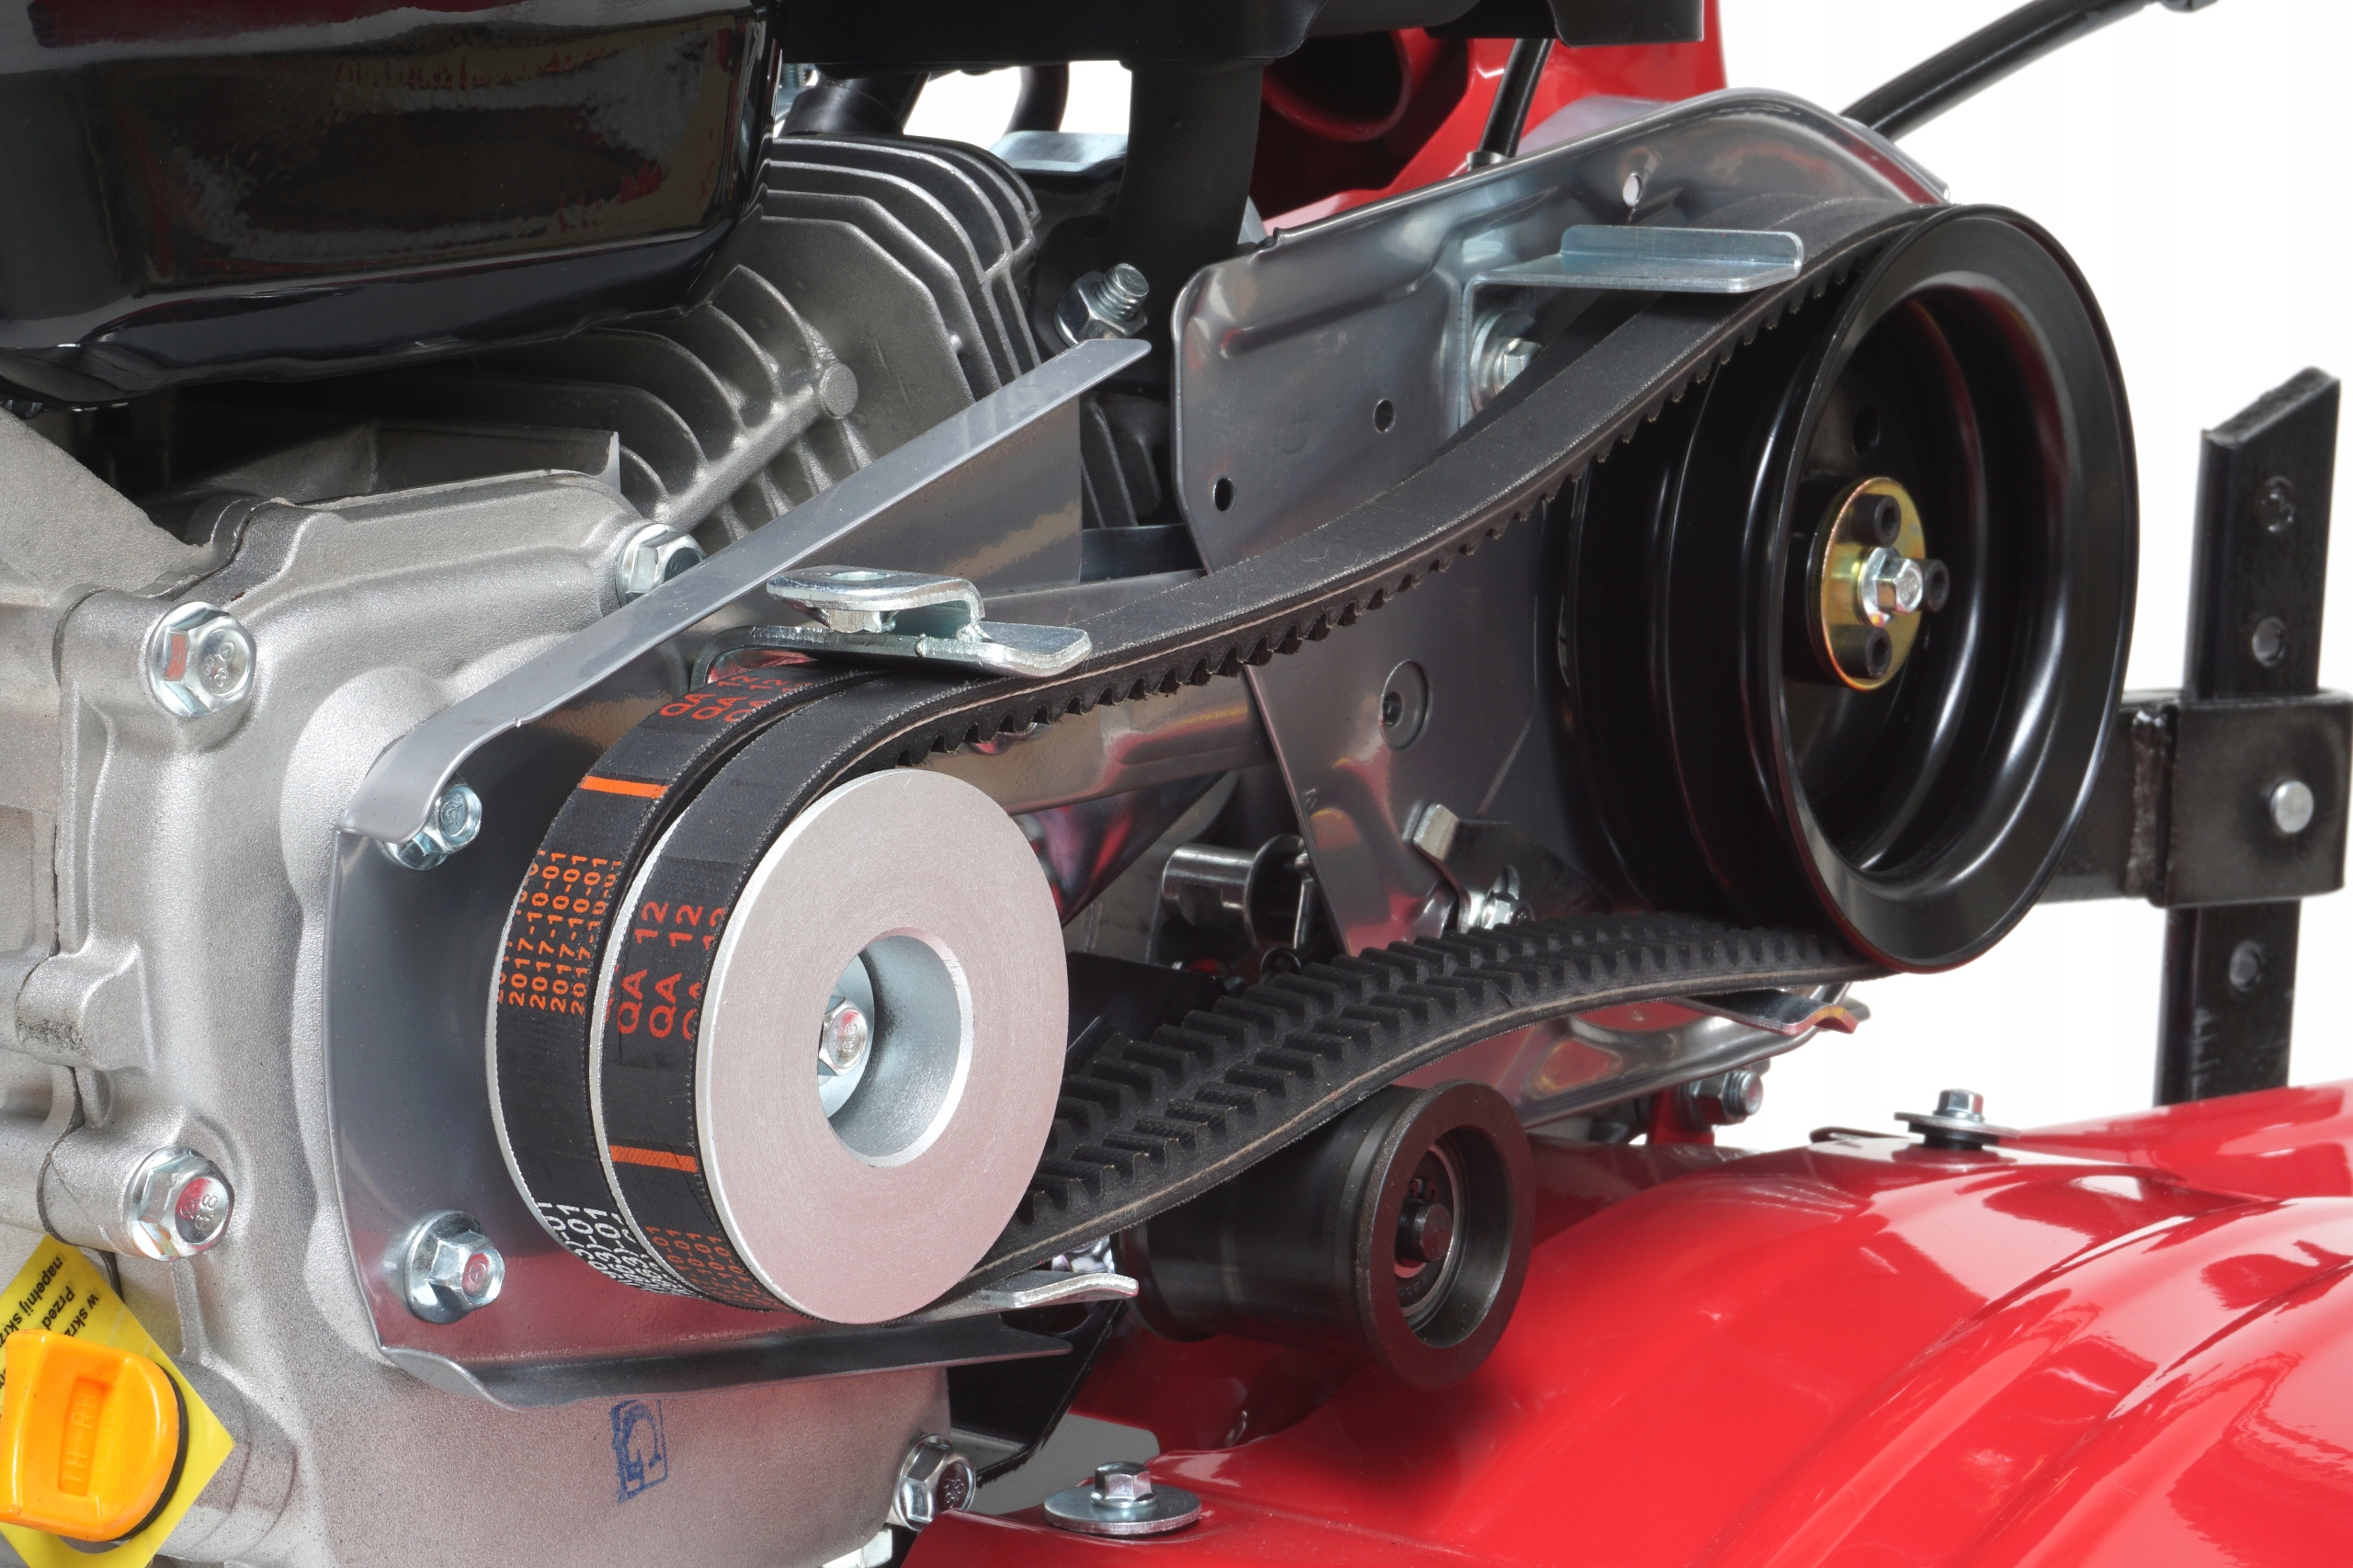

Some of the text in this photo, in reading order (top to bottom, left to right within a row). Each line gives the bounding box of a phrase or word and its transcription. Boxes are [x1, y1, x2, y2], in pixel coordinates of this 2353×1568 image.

[660, 676, 761, 718] QA 12
[692, 679, 791, 720] QA 12
[508, 852, 567, 1006] 2017-10-01
[529, 855, 588, 1010] 2017-10-01
[551, 858, 608, 1014] 2017-10-01
[570, 860, 622, 1017] 2017-10-01
[617, 901, 670, 1035] QA 12
[648, 972, 683, 1039] QA
[668, 904, 704, 948] 12
[18, 1256, 63, 1317] napełnij
[41, 1285, 75, 1331] Przed
[86, 1293, 100, 1311] w
